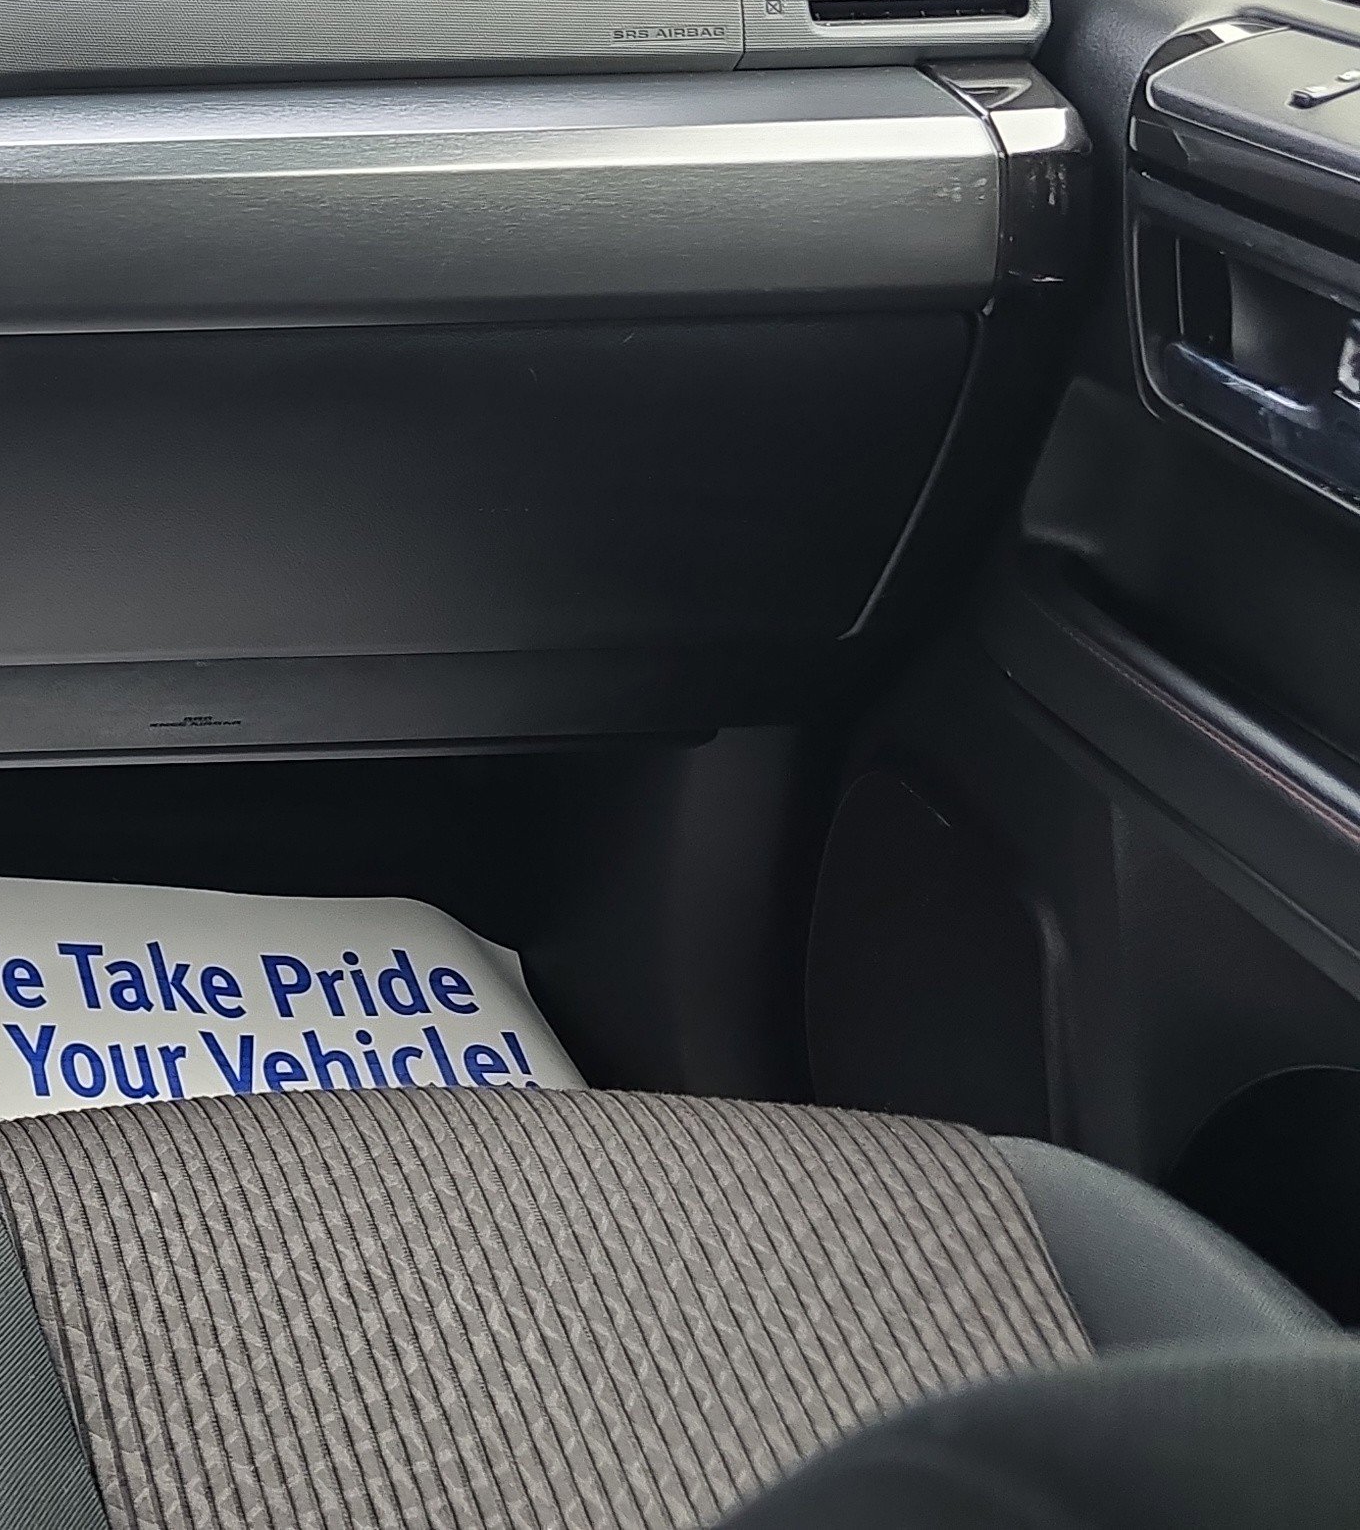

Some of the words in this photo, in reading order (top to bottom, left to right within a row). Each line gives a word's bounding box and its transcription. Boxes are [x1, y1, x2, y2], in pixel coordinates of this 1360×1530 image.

[613, 29, 649, 39] SRS
[655, 27, 725, 38] AIRBAG
[57, 940, 247, 1019] Take
[260, 948, 481, 1019] Pride
[3, 1022, 188, 1103] Your
[198, 1026, 541, 1097] Vehicle!
